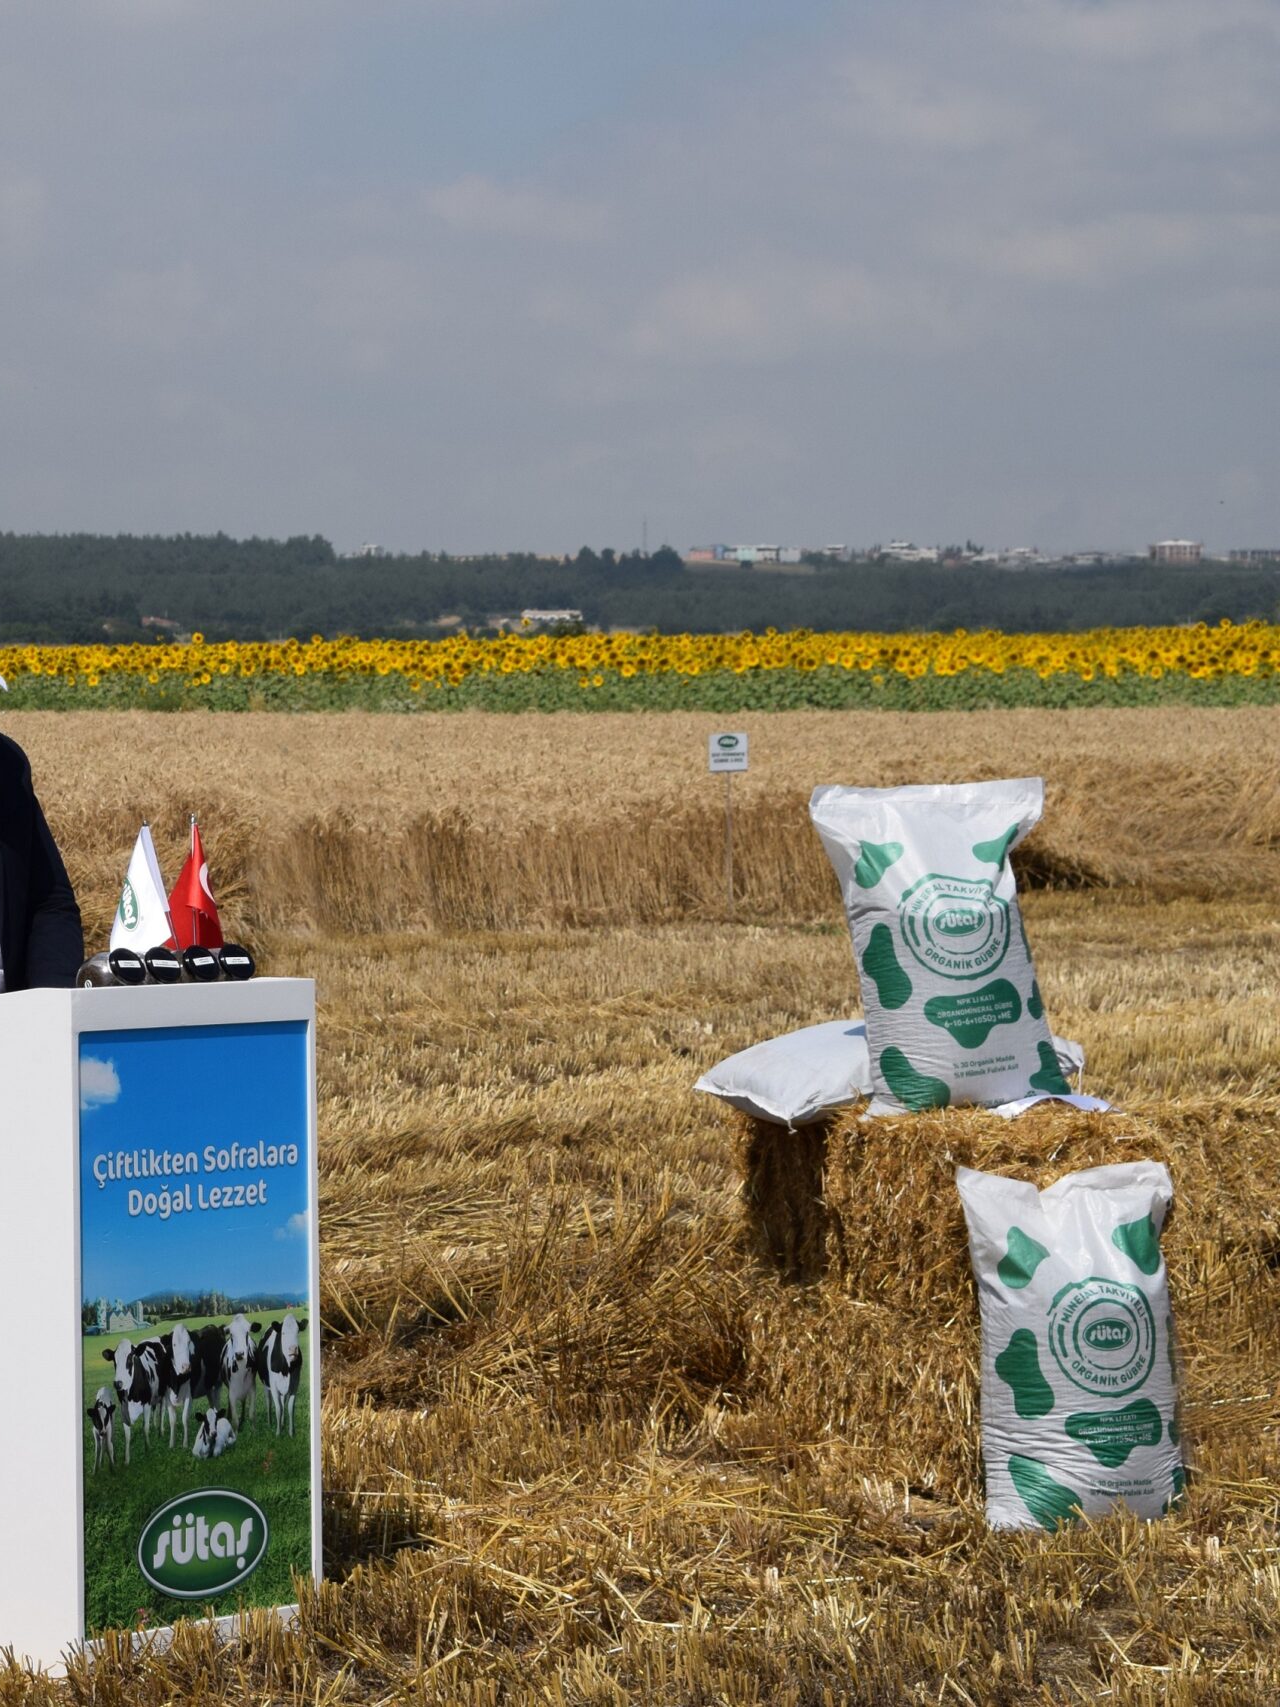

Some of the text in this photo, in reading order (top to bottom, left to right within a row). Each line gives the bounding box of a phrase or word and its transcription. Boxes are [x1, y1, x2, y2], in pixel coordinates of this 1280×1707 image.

[925, 938, 1001, 970] ORGANİK GÜBRE
[93, 1140, 299, 1189] Çiftlikten Sofralara
[128, 1179, 268, 1220] Doğal Lezzet
[1098, 1285, 1146, 1318] TAKVİYELİ
[1089, 1325, 1127, 1343] sütaş
[1071, 1354, 1146, 1386] ORGANİK GÜBRE
[153, 1512, 253, 1570] sütaş
